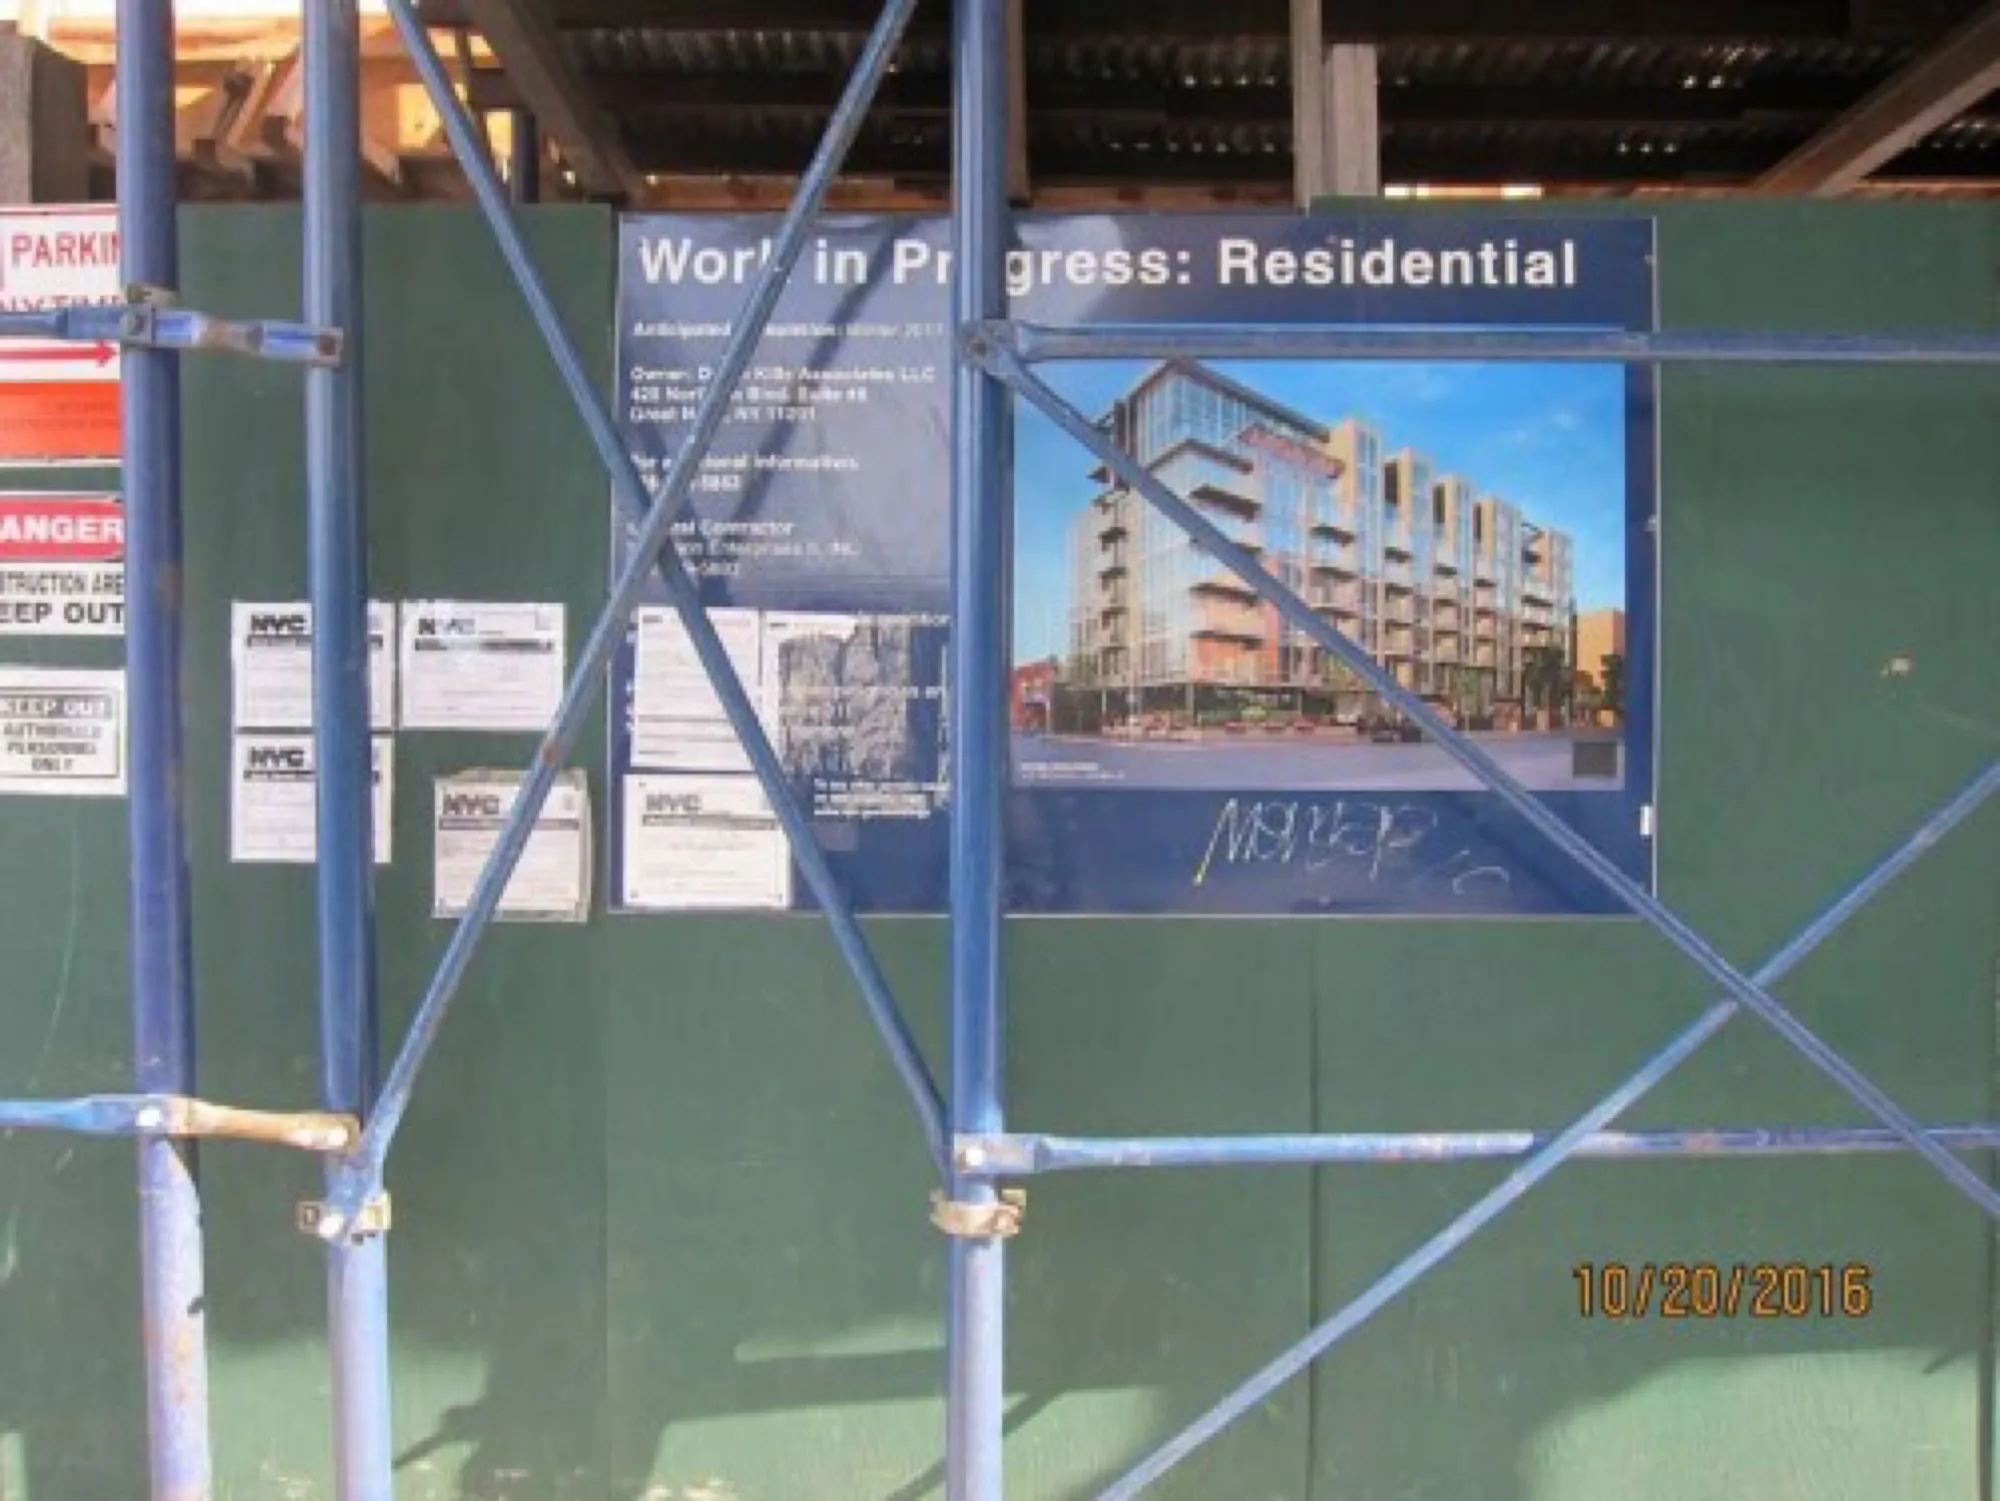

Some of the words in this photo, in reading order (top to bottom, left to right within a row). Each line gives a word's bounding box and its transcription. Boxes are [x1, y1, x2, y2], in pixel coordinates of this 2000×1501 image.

[814, 238, 868, 285] in
[892, 238, 1191, 297] Prgress:
[1217, 237, 1578, 286] Residential
[900, 366, 935, 383] LLC
[0, 514, 124, 543] ANGER
[0, 570, 85, 595] TRUCTION
[92, 570, 124, 595] ARE
[0, 602, 52, 624] EEP
[63, 602, 124, 624] OUT
[251, 614, 305, 633] NYC
[250, 747, 304, 767] NYC
[442, 795, 500, 815] NYC
